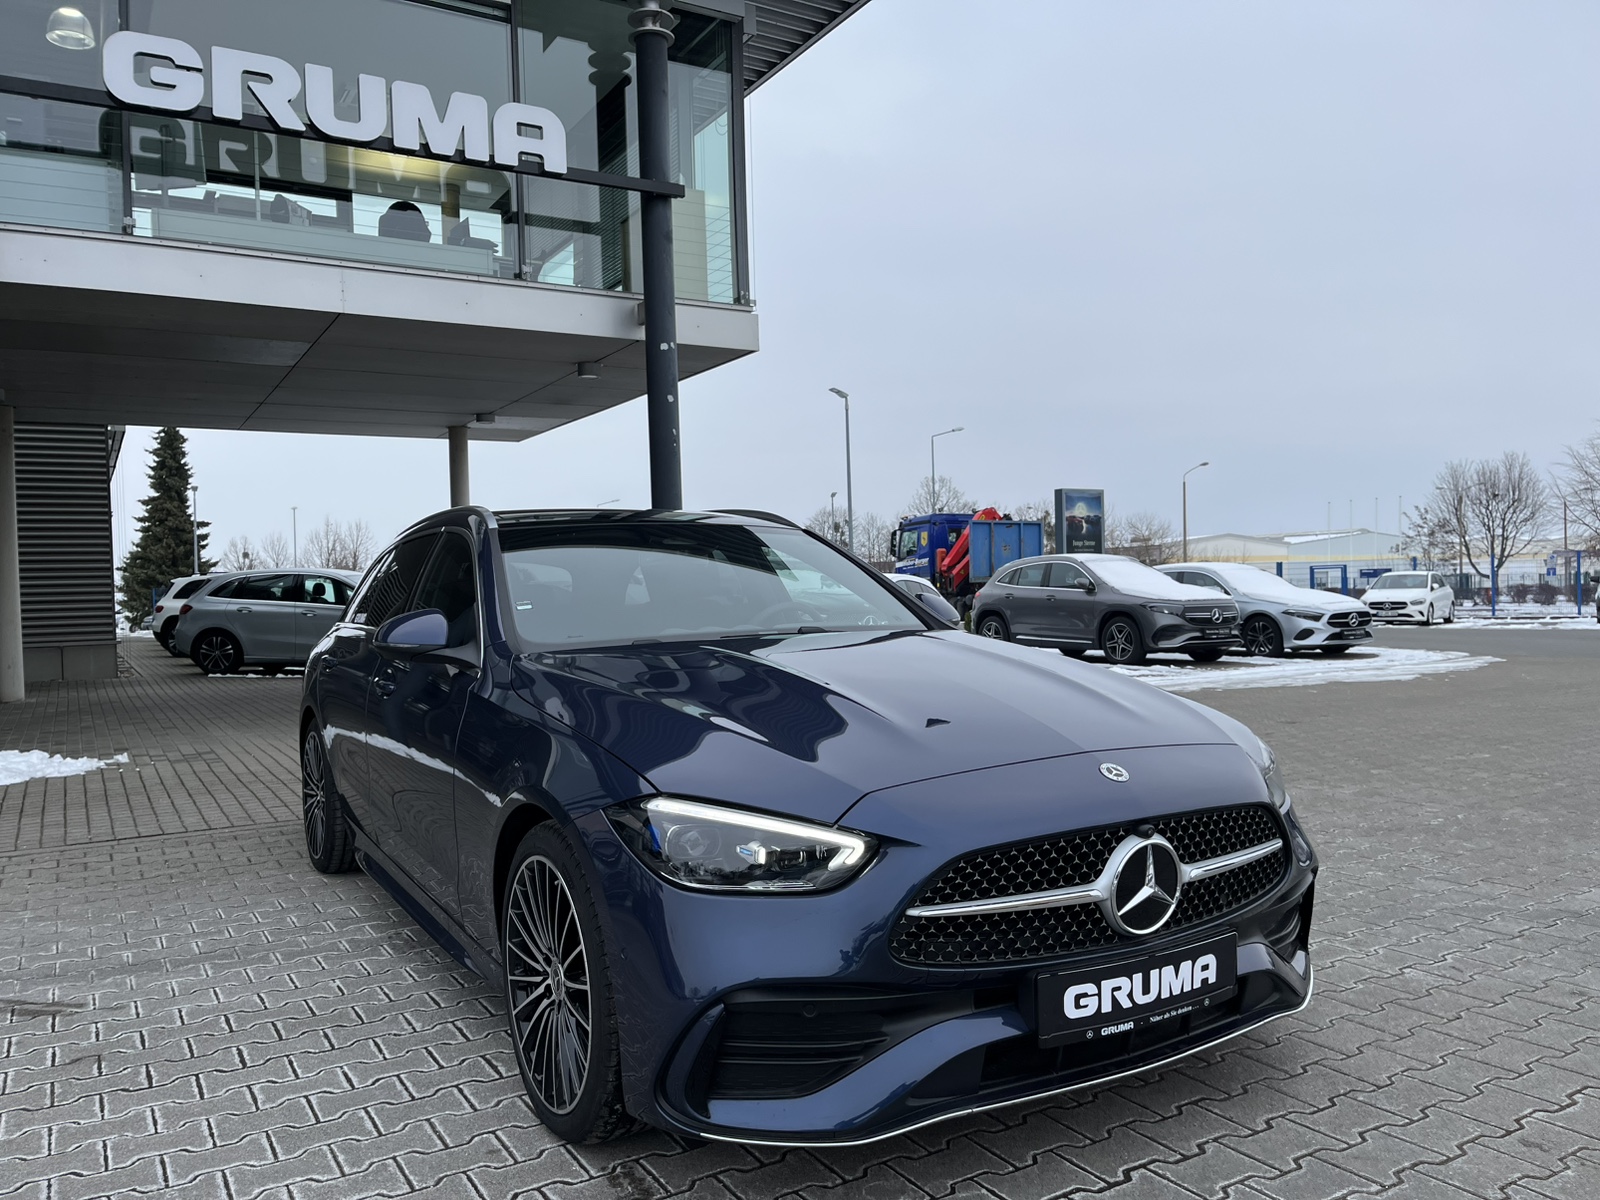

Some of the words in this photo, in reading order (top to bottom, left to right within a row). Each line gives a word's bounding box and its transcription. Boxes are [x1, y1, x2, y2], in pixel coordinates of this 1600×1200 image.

[102, 30, 567, 175] GRUMA
[1063, 953, 1217, 1019] GRUMA
[1101, 1021, 1134, 1036] GRUMA
[1149, 1014, 1163, 1023] Näher
